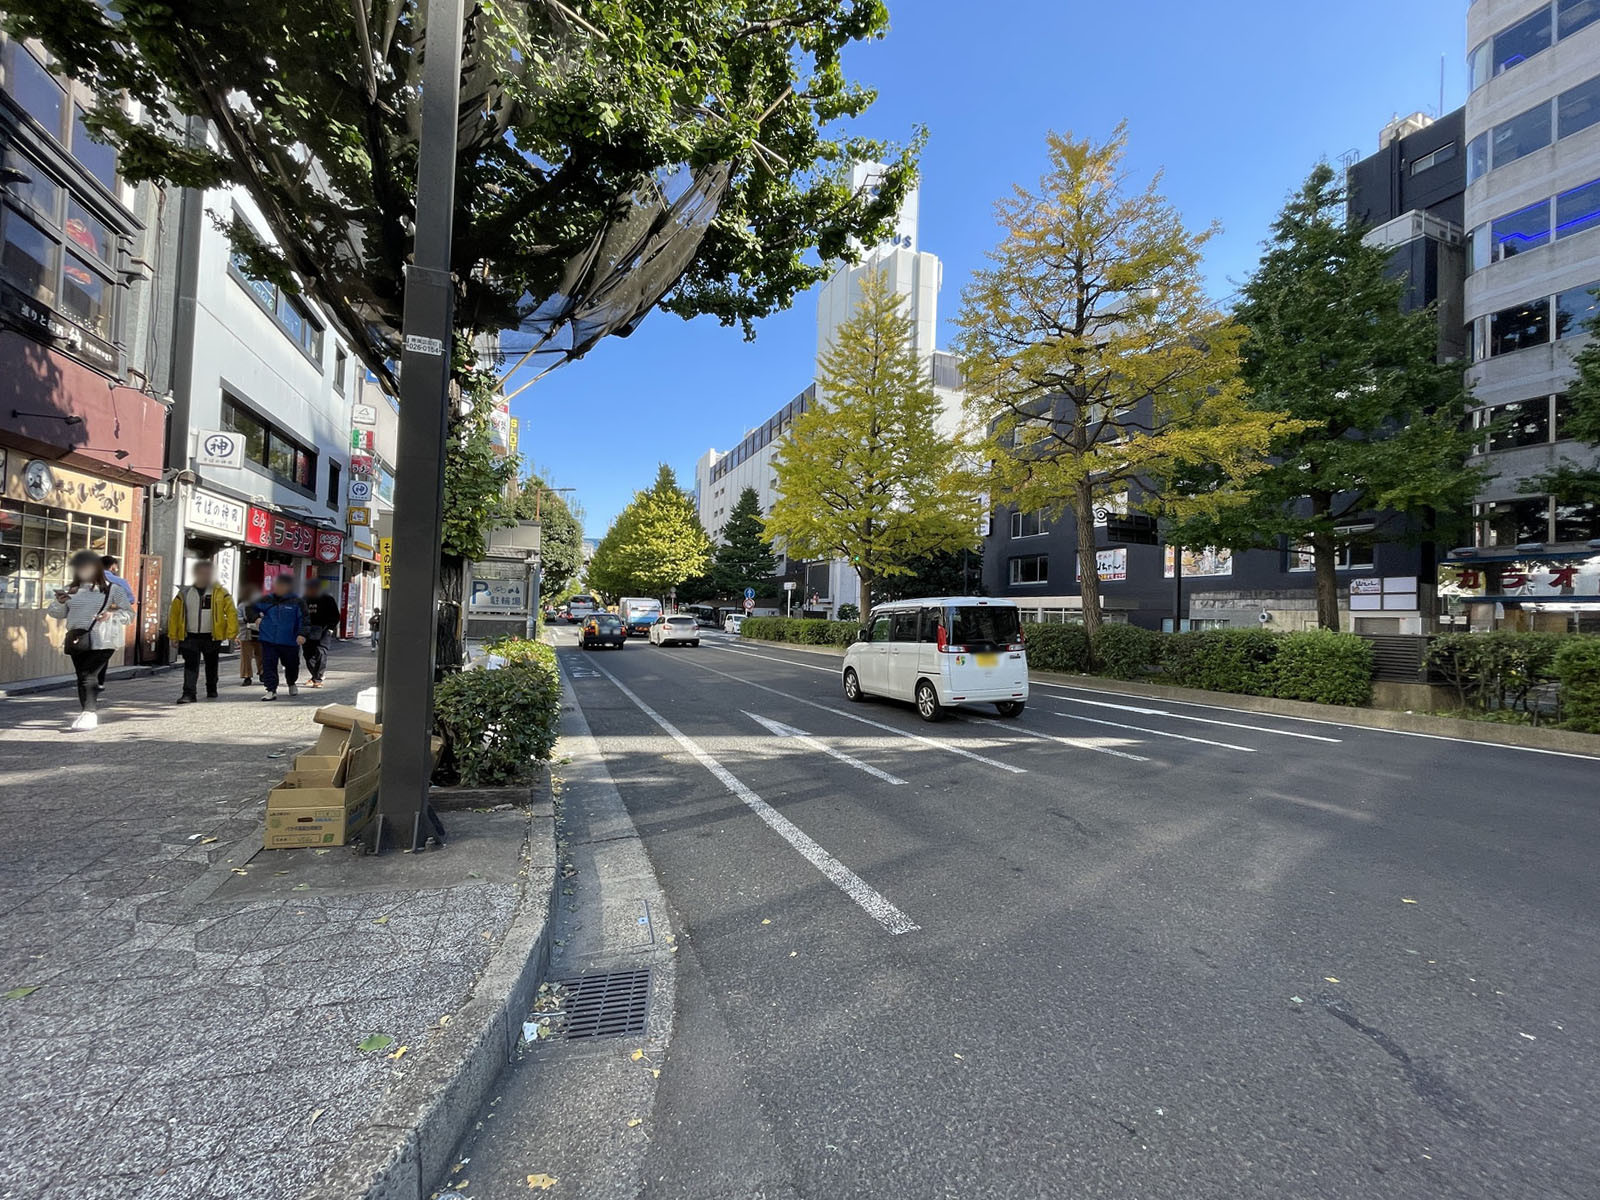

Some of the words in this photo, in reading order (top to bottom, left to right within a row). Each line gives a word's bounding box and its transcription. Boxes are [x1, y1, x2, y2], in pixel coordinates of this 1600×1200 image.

[210, 438, 229, 455] 神
[510, 418, 518, 452] SLOT
[274, 520, 312, 552] ラーメン
[1456, 565, 1600, 589] カラオ
[472, 581, 489, 605] P
